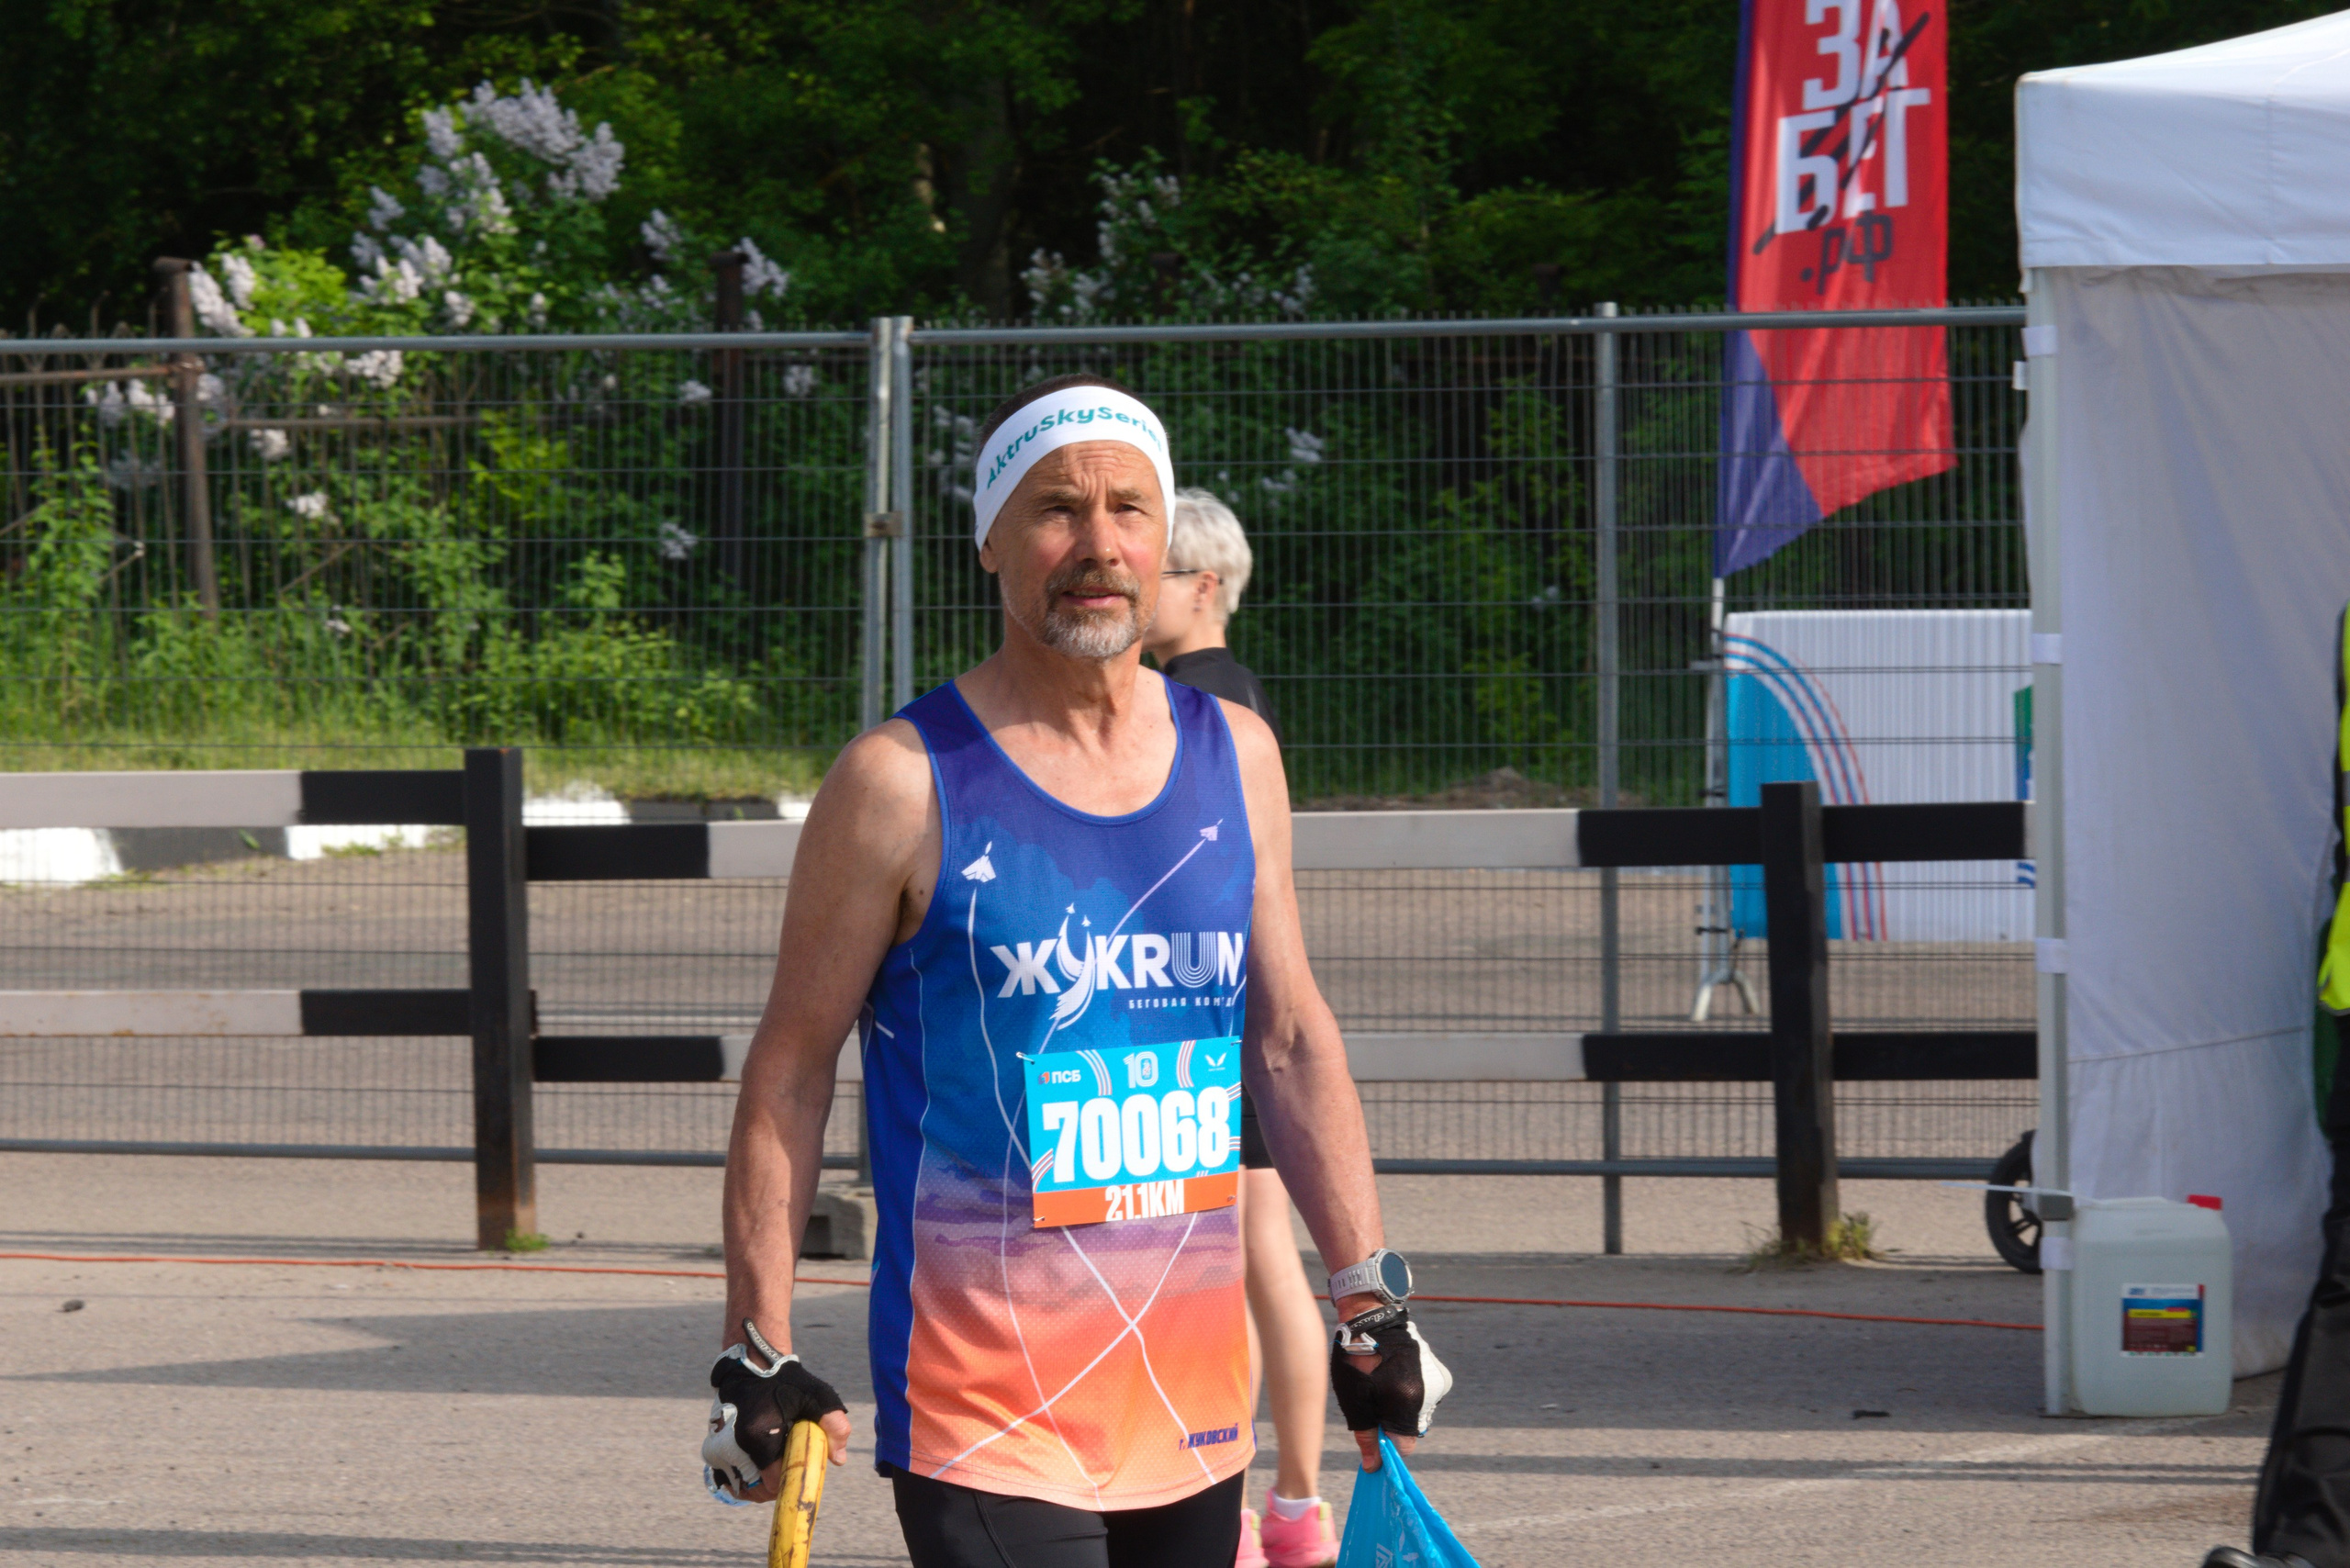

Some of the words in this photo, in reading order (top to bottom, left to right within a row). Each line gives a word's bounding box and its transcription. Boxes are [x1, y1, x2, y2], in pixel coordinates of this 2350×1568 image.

[1802, 0, 1908, 111] ЗА
[1128, 997, 1188, 1010] БЕГОВАЯ
[1051, 1070, 1082, 1084] ПСБ
[1122, 1050, 1159, 1089] 10
[1041, 1085, 1231, 1184] 70068
[1104, 1179, 1185, 1223] 21.1KM
